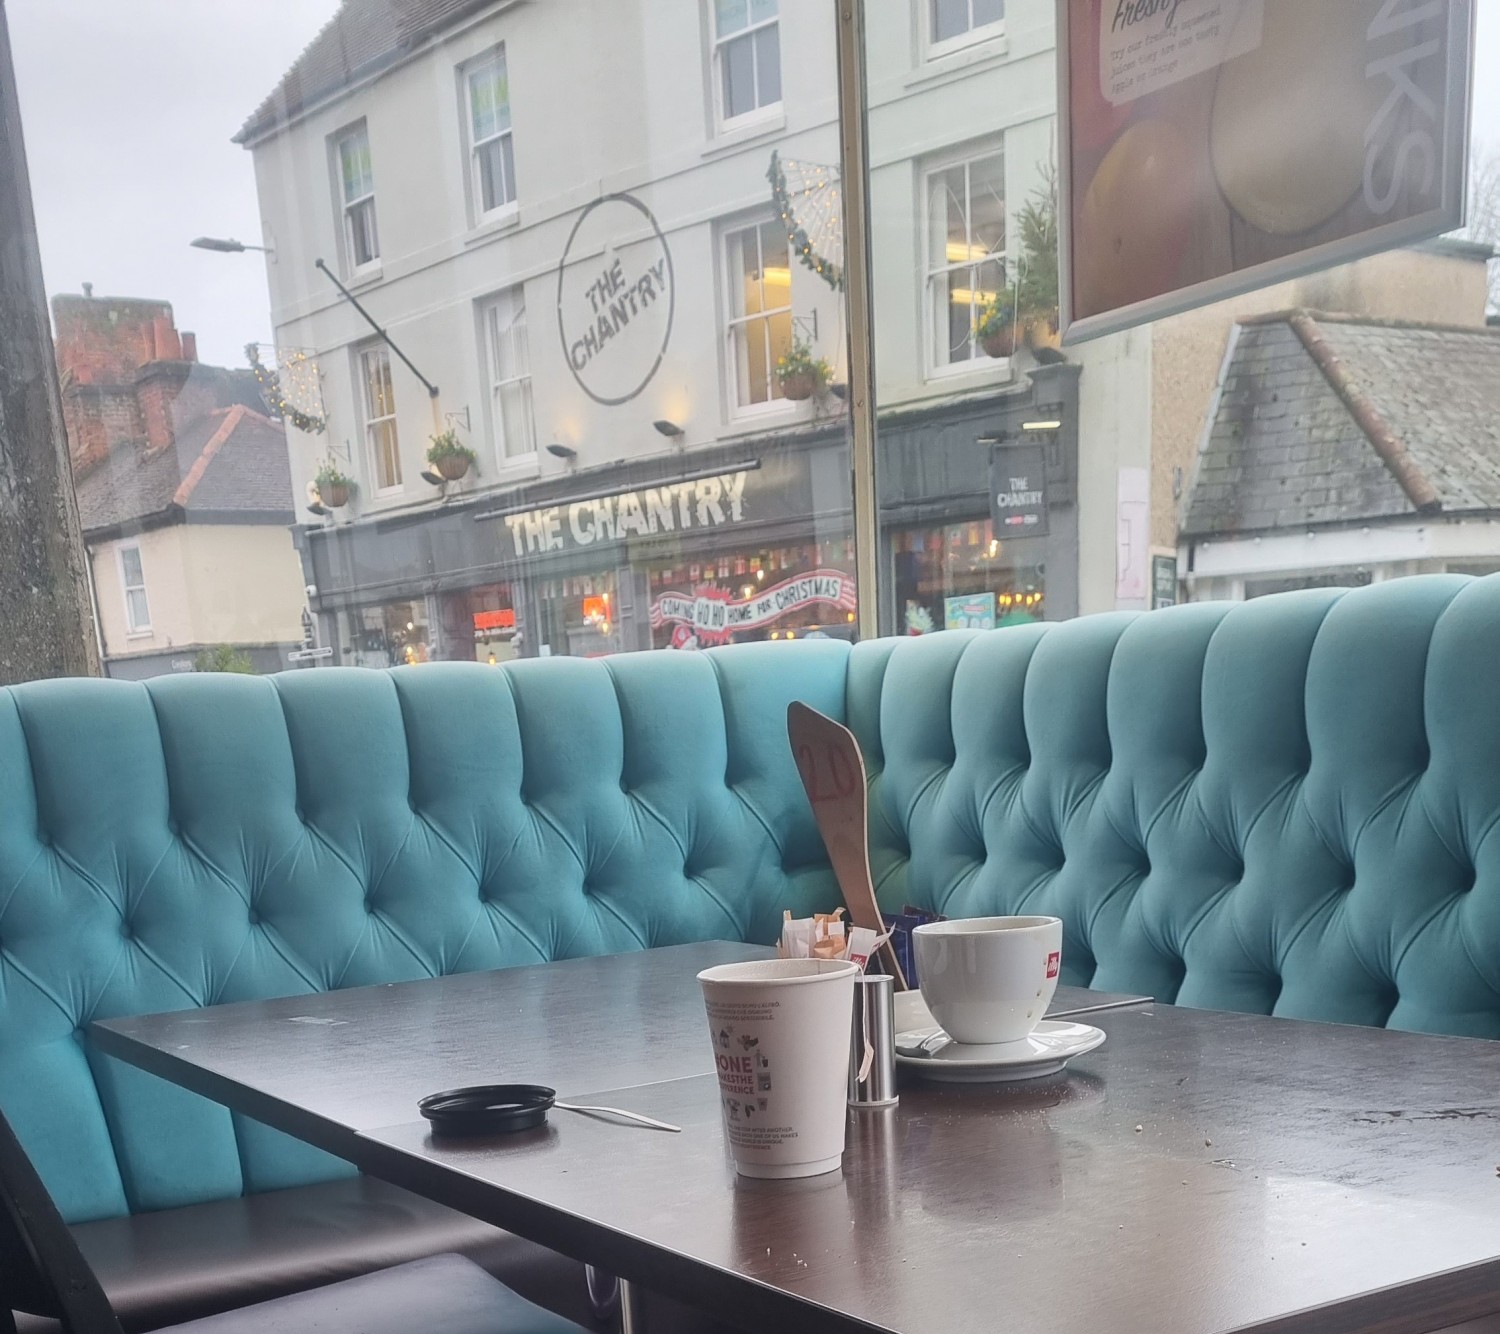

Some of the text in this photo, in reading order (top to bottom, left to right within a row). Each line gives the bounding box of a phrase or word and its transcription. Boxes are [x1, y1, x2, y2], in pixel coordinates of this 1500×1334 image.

[585, 258, 625, 314] THE
[571, 258, 665, 371] CHANTRY
[997, 490, 1044, 508] CHANTRY
[1009, 477, 1029, 491] THE
[504, 471, 748, 557] THE CHANTRY
[697, 603, 710, 625] HO
[711, 604, 725, 627] HO
[727, 604, 753, 623] HOME
[757, 599, 772, 615] FOR
[775, 578, 839, 610] CHRISTMAS
[1047, 956, 1059, 976] illy
